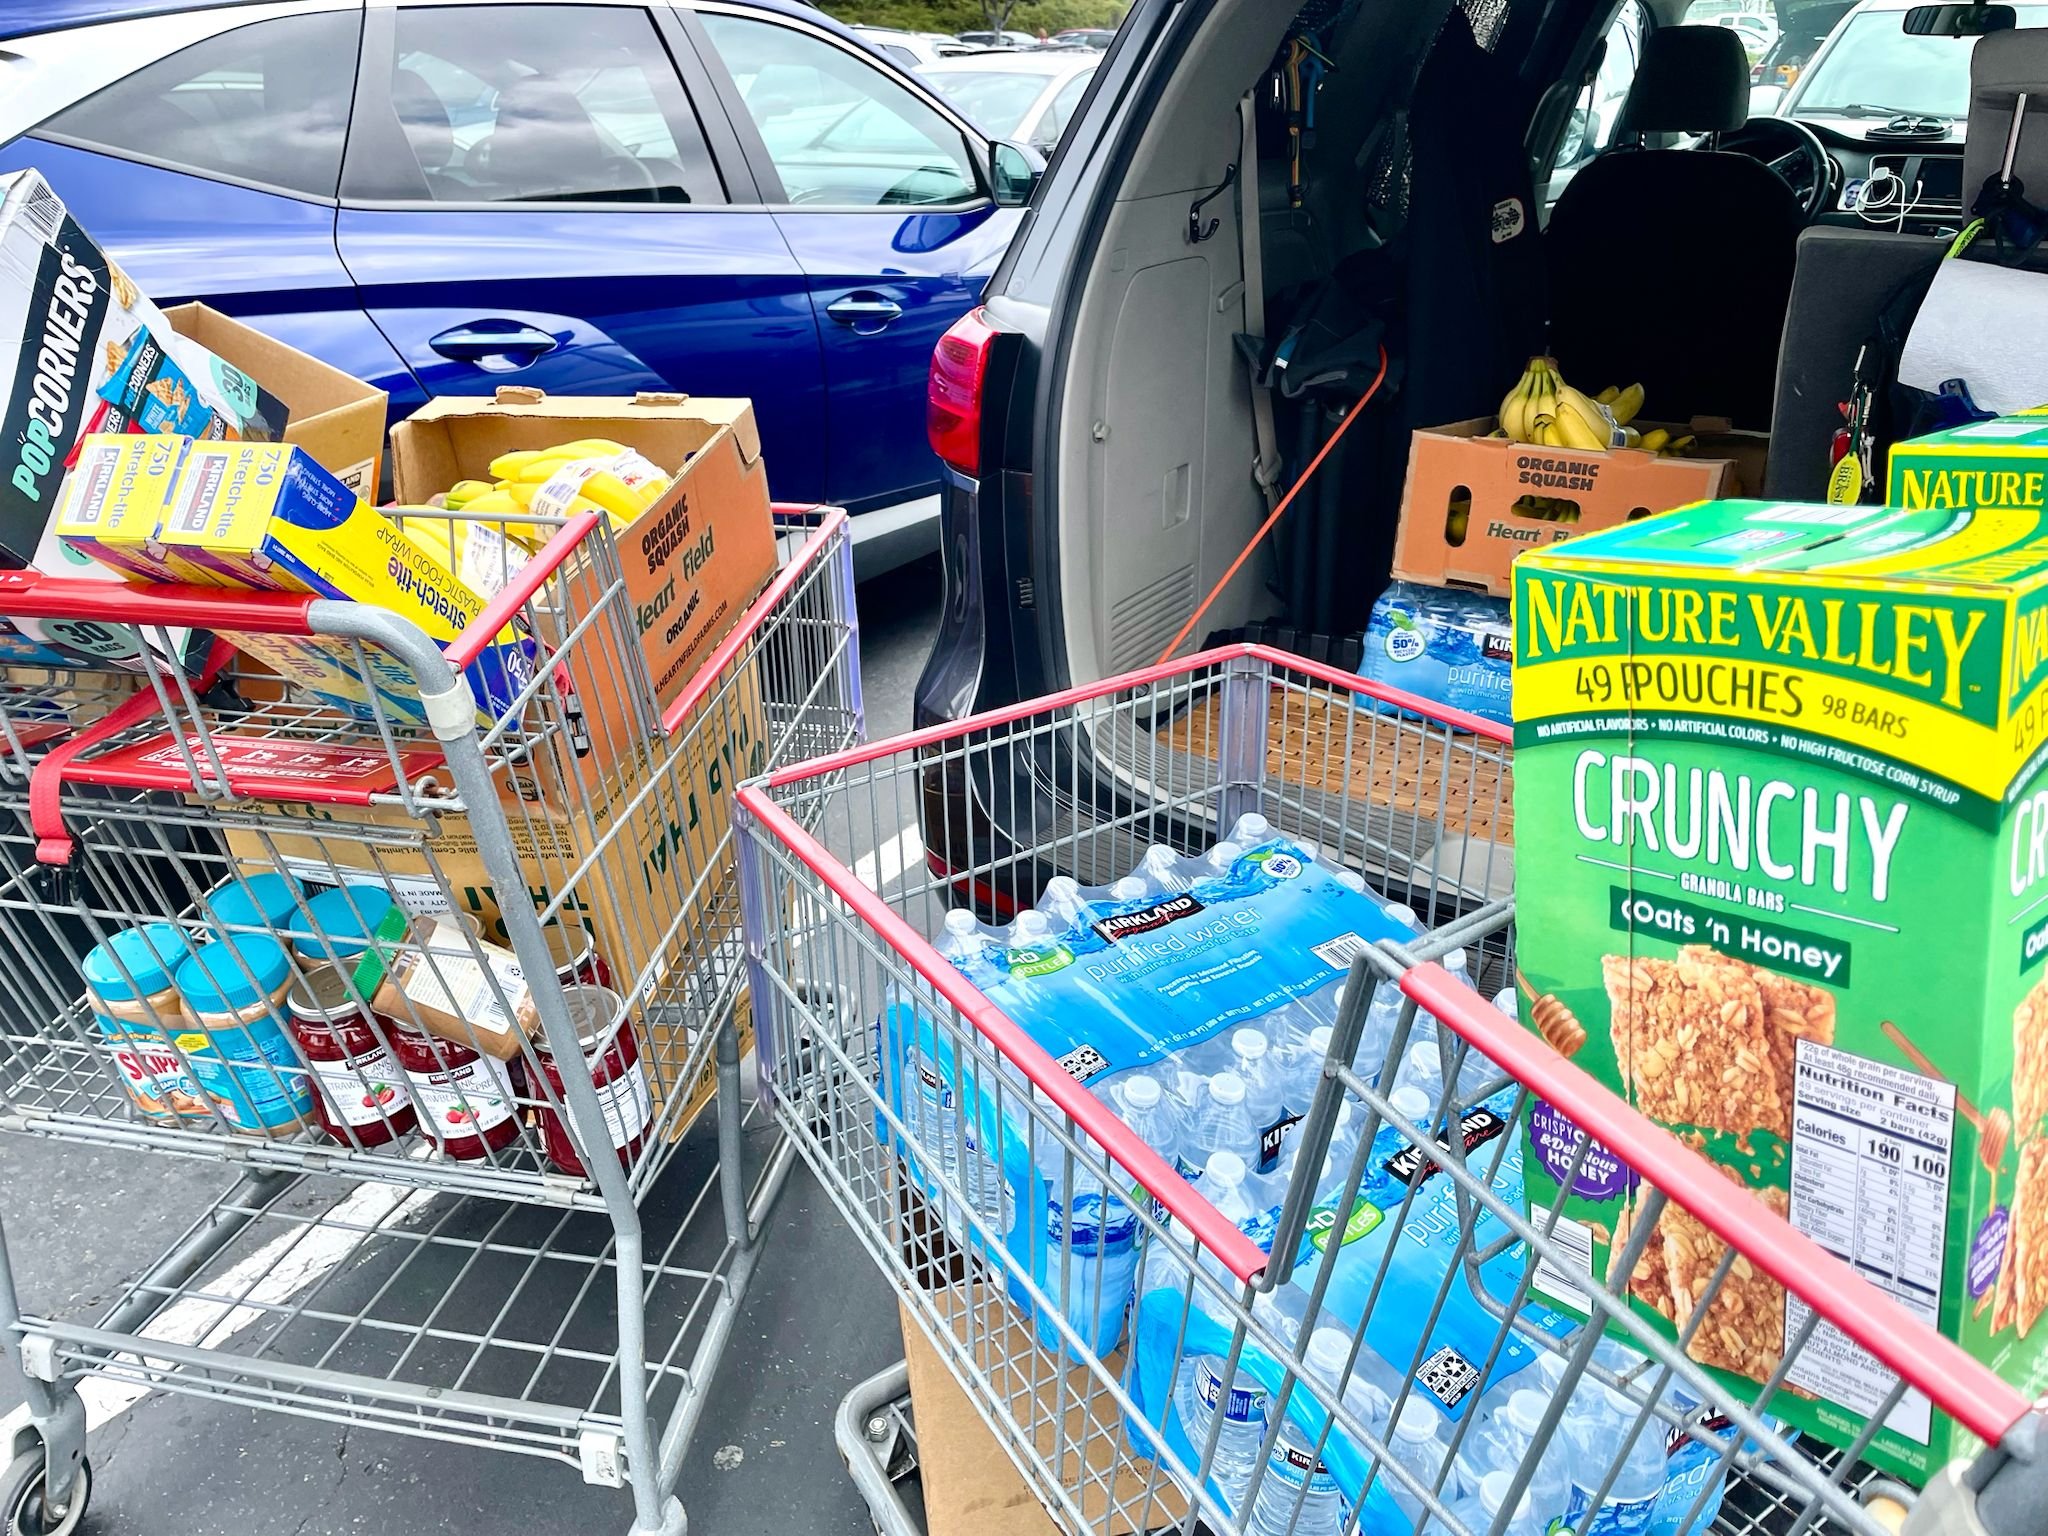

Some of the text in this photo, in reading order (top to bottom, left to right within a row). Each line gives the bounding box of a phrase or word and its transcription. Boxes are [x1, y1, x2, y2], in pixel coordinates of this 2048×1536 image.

[149, 441, 174, 476] 750
[255, 450, 281, 485] 750
[1517, 456, 1600, 477] ORGANIC
[85, 451, 120, 520] KIRKLAND
[191, 459, 226, 529] KIRKLAND
[1519, 471, 1594, 491] SQUASH
[1903, 470, 2045, 510] NATURE
[376, 527, 411, 557] WRAP
[642, 493, 689, 556] ORGANIC
[647, 515, 690, 575] SQUASH
[1487, 522, 1541, 542] Heart
[411, 554, 445, 585] FOOD
[682, 525, 715, 582] Field
[388, 556, 467, 631] stretch-tite
[445, 573, 482, 617] PLASTIC
[53, 621, 114, 646] 30
[665, 589, 700, 645] ORGANIC
[1393, 638, 1419, 649] 50%
[1526, 579, 1742, 659] NATURE
[1747, 595, 1987, 710] VALLEY
[1575, 667, 1613, 703] 49
[1822, 695, 1846, 721] 98
[1851, 700, 1909, 740] BARS
[1537, 725, 1548, 738] NO
[1658, 718, 1673, 732] NO
[1674, 720, 1728, 738] ARTIFICIAL
[1729, 724, 1770, 745] COLORS
[1780, 734, 1798, 750] NO
[1799, 737, 1828, 757] HIGH
[1828, 745, 1887, 780] FRUCTOSE
[1887, 765, 1921, 792] CORN
[1922, 778, 1961, 805] SYRUP
[1573, 749, 1909, 902] CRUNCHY
[1680, 871, 1786, 913] GRANOLA BARS
[1100, 897, 1193, 935] KIRKLAND
[1086, 904, 1263, 982] purified water
[1184, 943, 1214, 962] added
[1214, 935, 1231, 951] for
[1741, 926, 1843, 978] Honey
[1803, 1053, 1813, 1062] At
[1814, 1055, 1836, 1069] least
[1837, 1063, 1853, 1077] 48g
[1854, 1069, 1917, 1095] recommended
[1821, 1048, 1830, 1057] of
[1831, 1051, 1858, 1067] whole
[1859, 1060, 1882, 1074] grain
[1882, 1067, 1898, 1080] per
[1799, 1065, 1950, 1123] Nutrition Facts
[1814, 1086, 1858, 1107] servings
[1859, 1101, 1878, 1113] per
[1879, 1107, 1931, 1130] container
[1534, 1112, 1573, 1140] CRISPY
[1798, 1090, 1949, 1148] Serving size 2 bars (42g)
[1796, 1118, 1946, 1180] Calories 190 100
